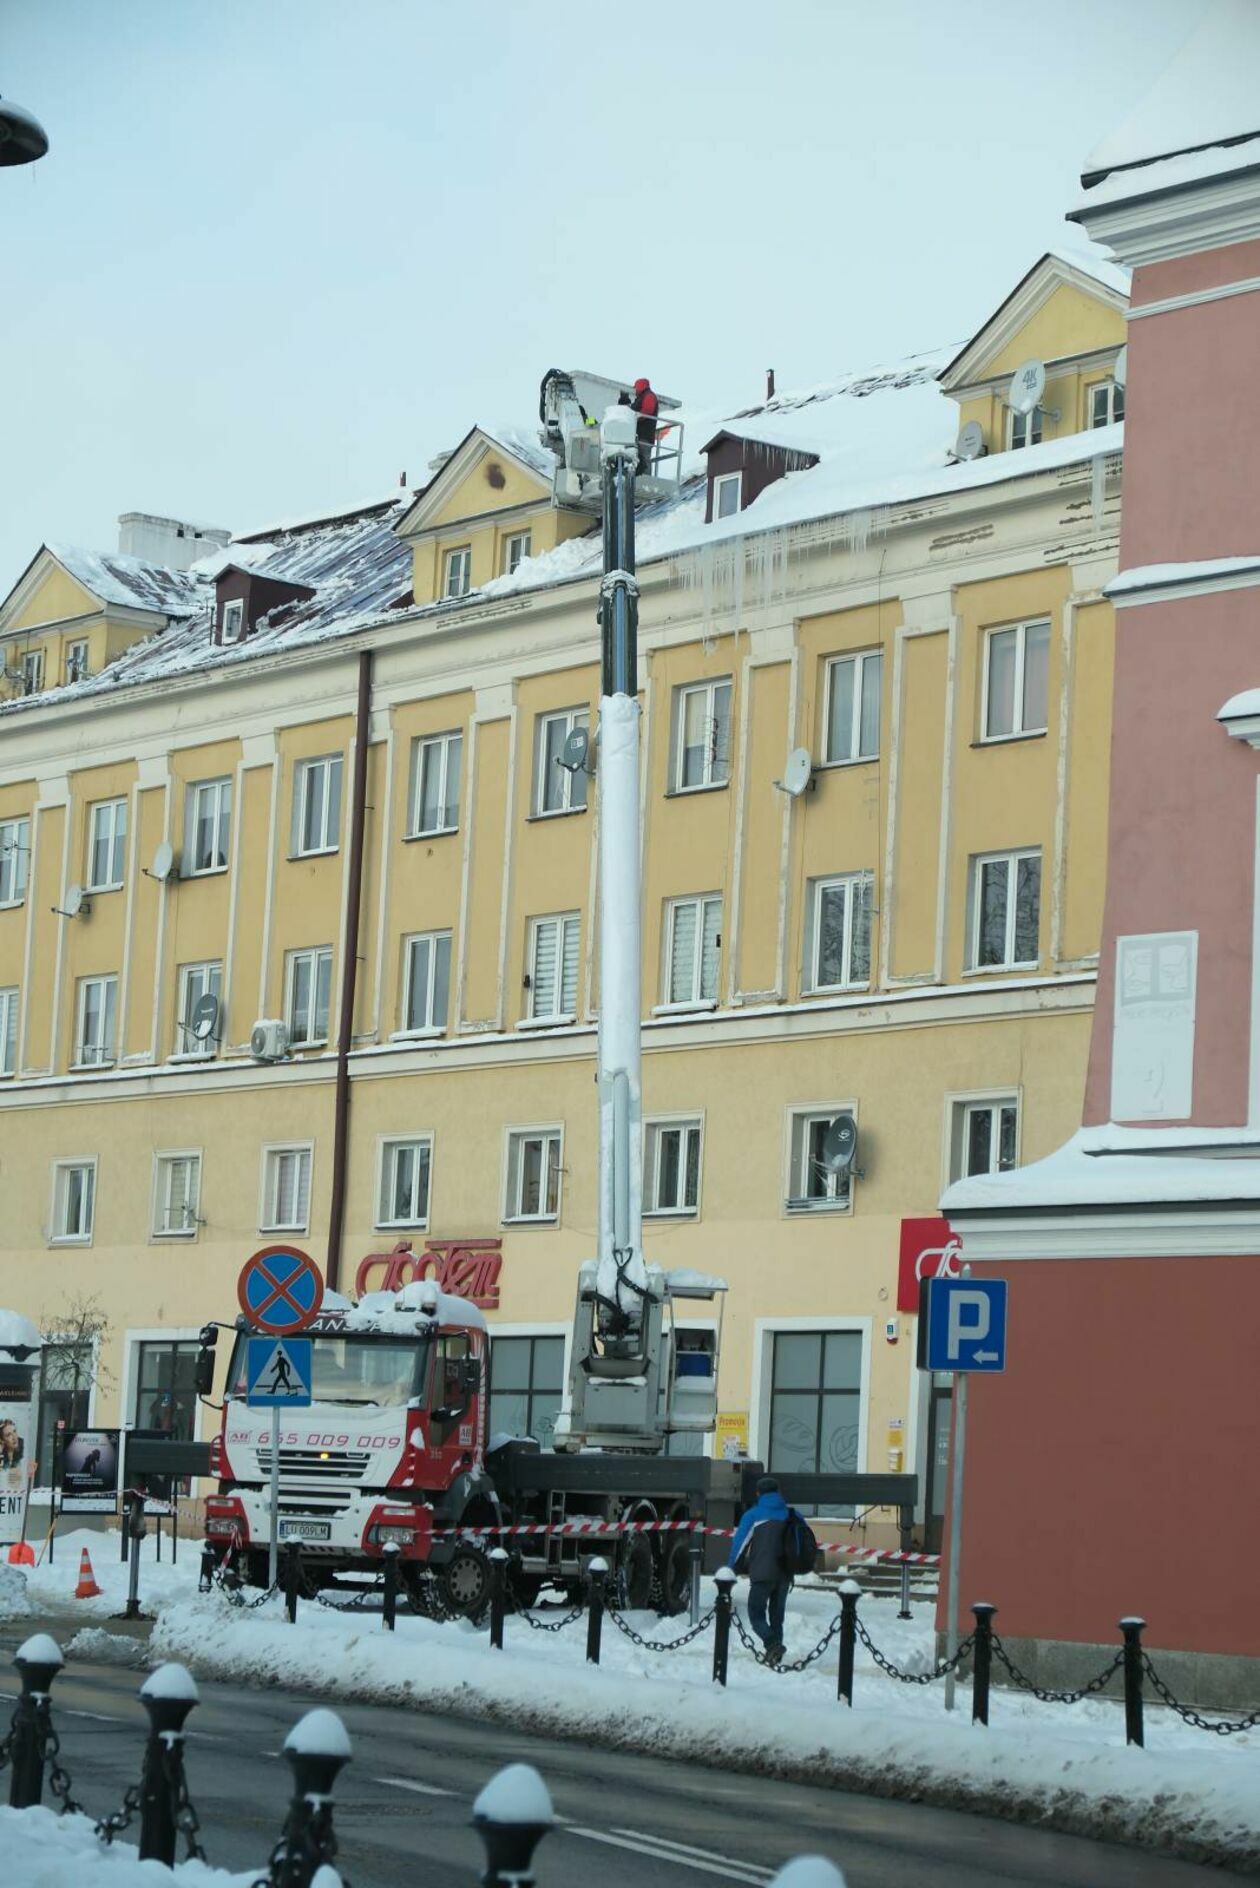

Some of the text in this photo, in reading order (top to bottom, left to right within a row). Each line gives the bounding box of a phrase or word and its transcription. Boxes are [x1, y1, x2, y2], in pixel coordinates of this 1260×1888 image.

[948, 1290, 990, 1360] P
[307, 1434, 349, 1446] 009
[357, 1436, 401, 1448] 009
